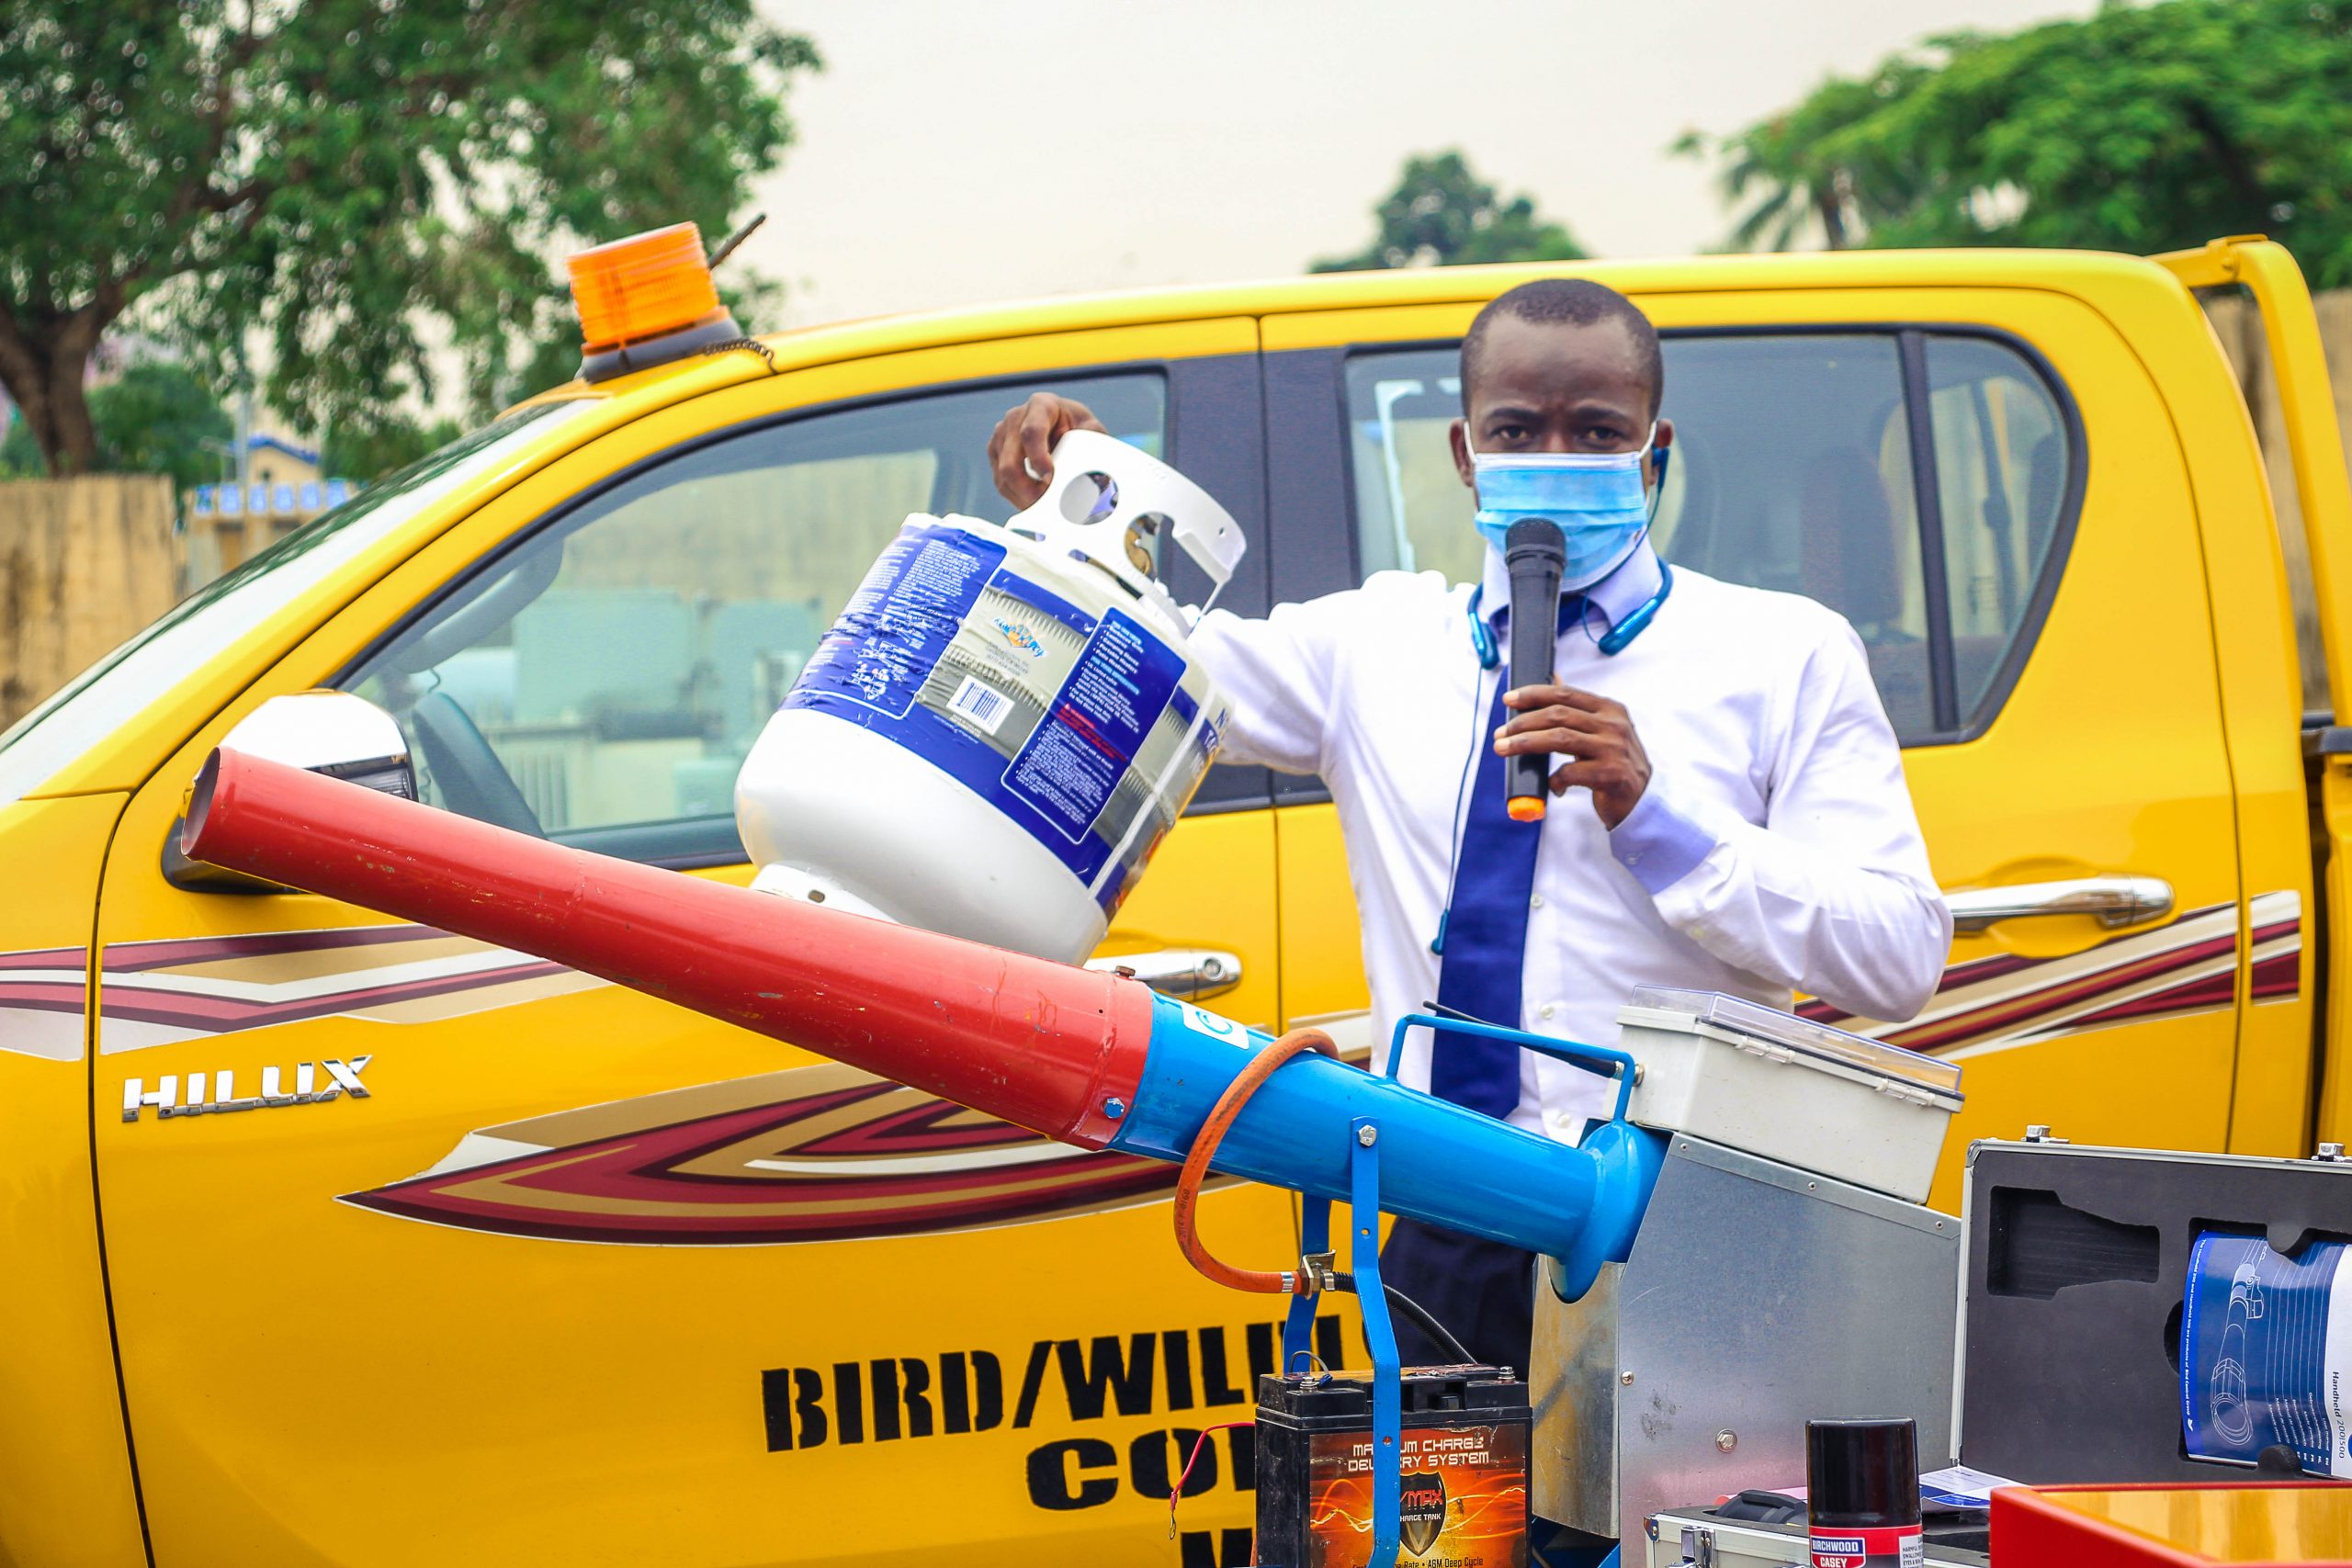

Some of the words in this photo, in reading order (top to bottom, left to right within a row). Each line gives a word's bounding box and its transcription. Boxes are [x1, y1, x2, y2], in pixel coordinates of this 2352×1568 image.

[122, 1055, 372, 1122] HILUX
[2332, 1371, 2342, 1418] Handheld
[1422, 1436, 1484, 1452] CHARGE
[1428, 1451, 1489, 1467] SYSTEM
[1423, 1513, 1441, 1521] TANK
[1811, 1539, 1859, 1552] BIRCHWOOD
[1464, 1557, 1484, 1568] Cycle
[1820, 1557, 1848, 1568] CASEY
